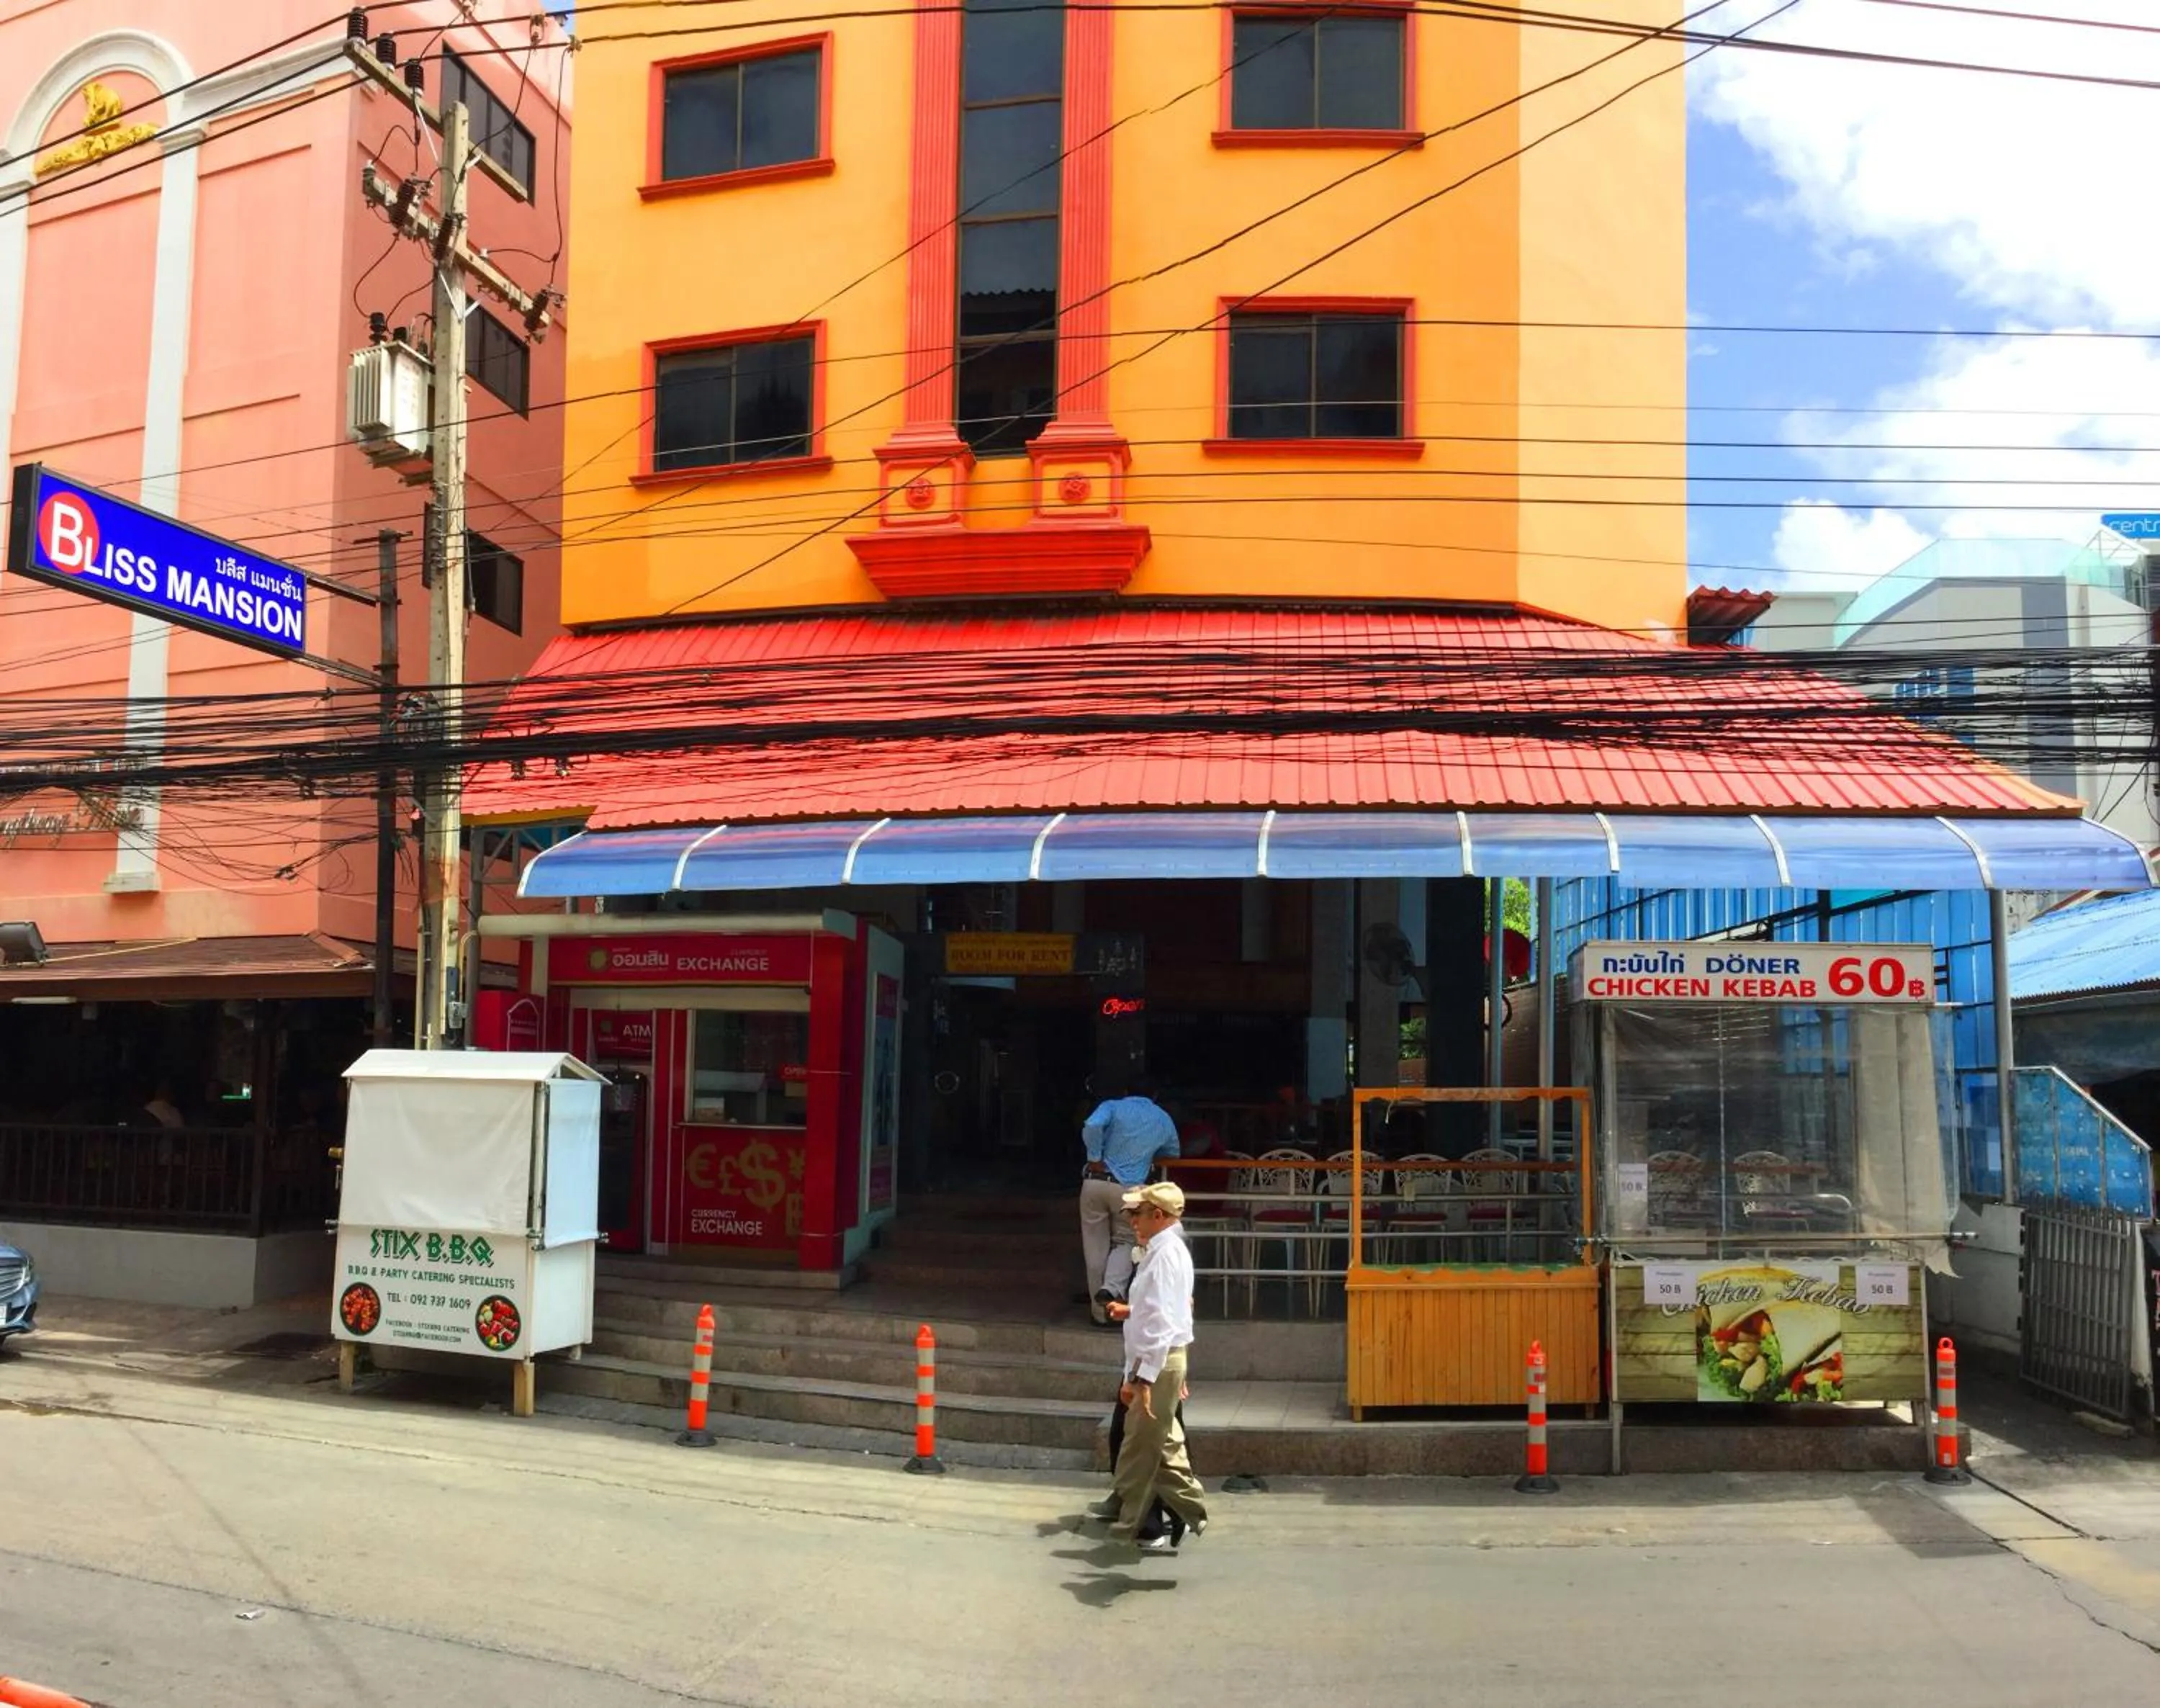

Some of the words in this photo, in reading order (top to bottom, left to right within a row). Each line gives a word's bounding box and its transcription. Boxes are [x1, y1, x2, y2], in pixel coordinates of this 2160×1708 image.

[167, 565, 302, 642] MANSION
[951, 948, 991, 961] ROOM
[998, 948, 1026, 961] FOR
[1031, 949, 1071, 962] RENT
[677, 957, 770, 971] EXCHANGE
[1706, 954, 1801, 974] DÖNER
[1588, 978, 1710, 997] CHICKEN
[1723, 980, 1817, 997] KEBAB
[623, 1025, 652, 1038] ATM
[690, 1209, 737, 1218] CURRENCY
[690, 1219, 764, 1236] EXCHANGE
[370, 1228, 422, 1262] STIX
[380, 1268, 408, 1280] PARTY
[411, 1270, 455, 1283] CATERING
[459, 1274, 516, 1289] SPECIALISTS
[1660, 1284, 1671, 1294] 50
[1871, 1285, 1884, 1294] 50
[387, 1292, 401, 1303] TEL
